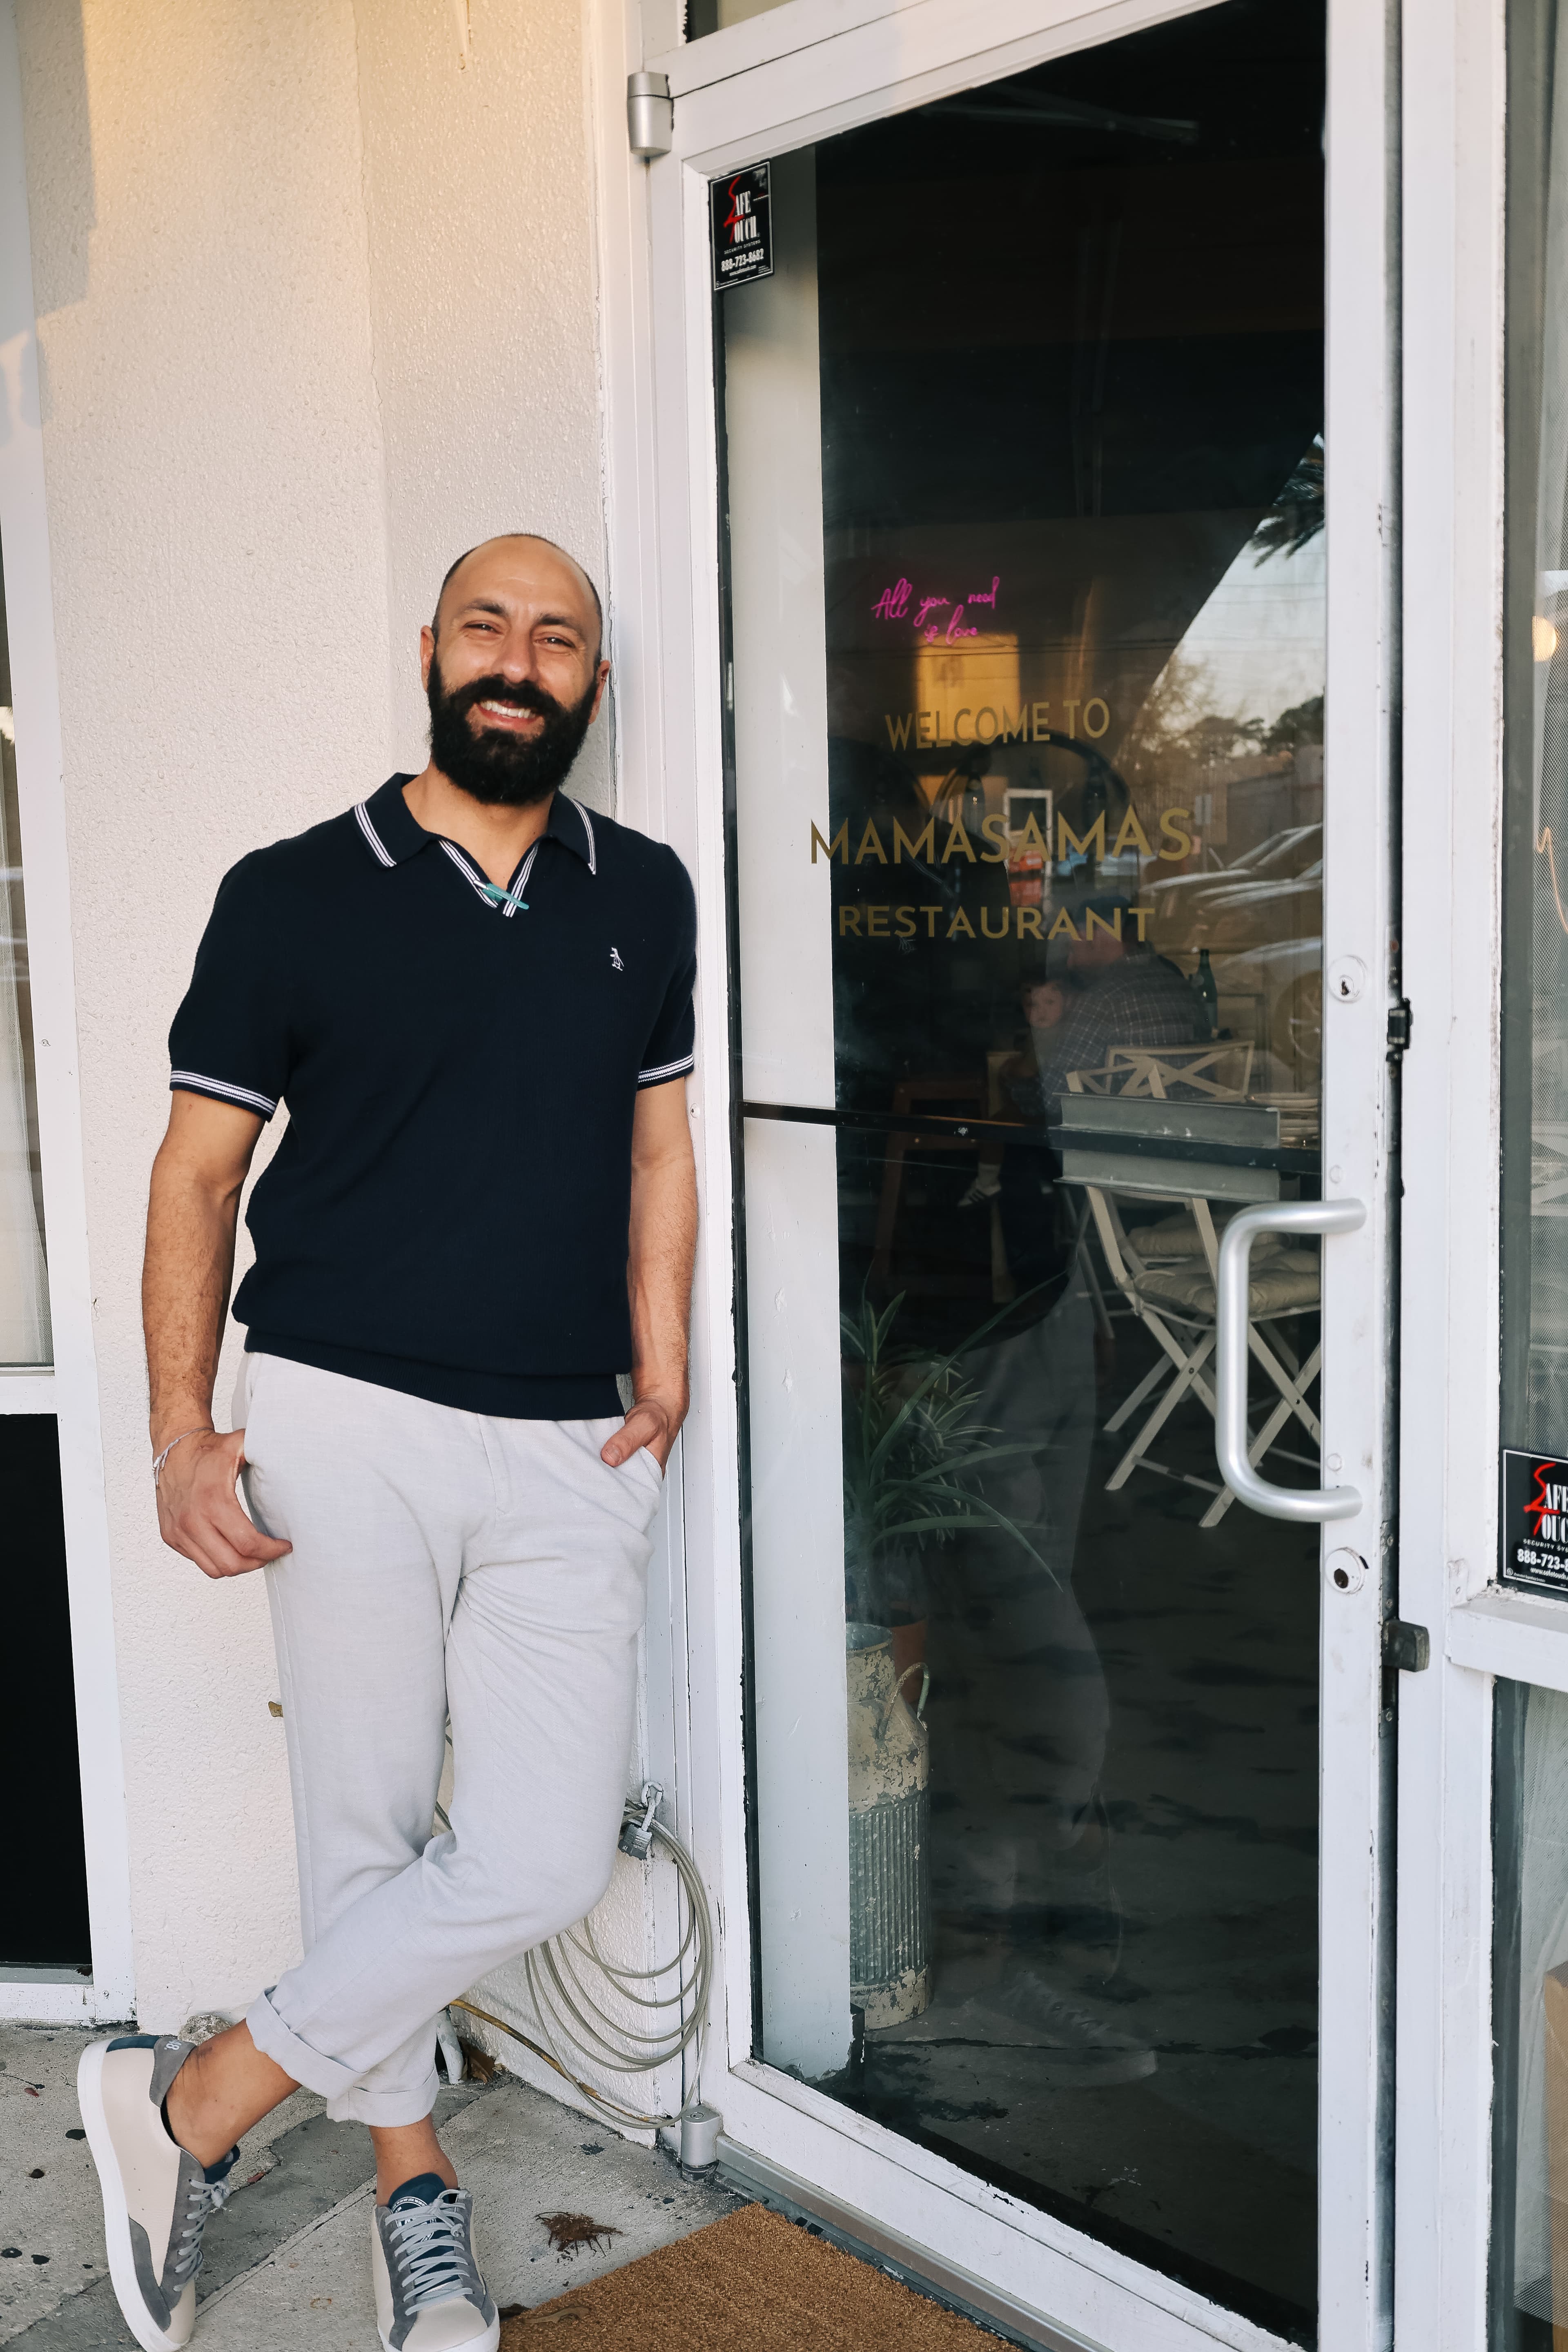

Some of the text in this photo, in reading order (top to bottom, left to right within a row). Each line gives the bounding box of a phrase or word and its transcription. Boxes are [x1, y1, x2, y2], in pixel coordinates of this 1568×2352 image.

[871, 576, 1000, 627] All you need
[946, 604, 978, 645] love
[884, 697, 1109, 752] WELCOME TO
[811, 804, 1193, 865] MAMASAMAS
[839, 906, 1155, 942] RESTAURANT
[1522, 1538, 1555, 1550] SECURITY
